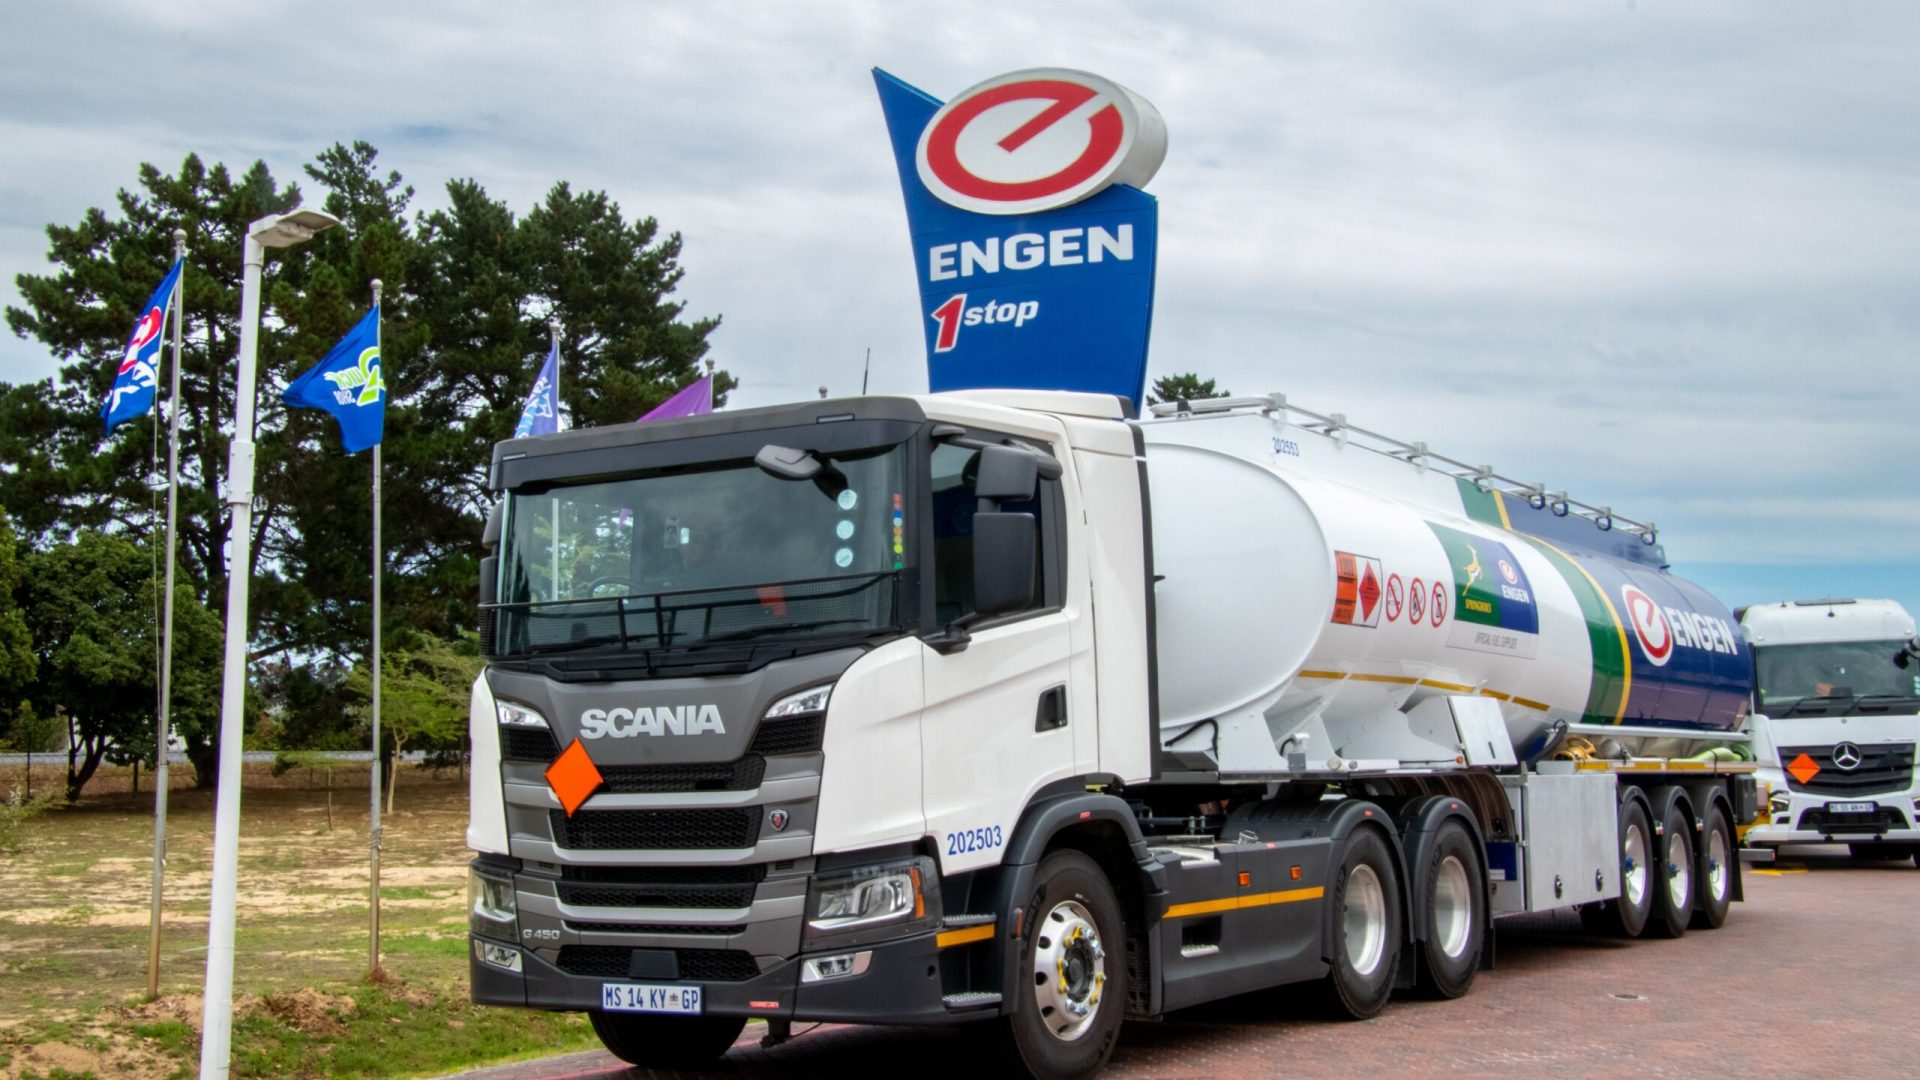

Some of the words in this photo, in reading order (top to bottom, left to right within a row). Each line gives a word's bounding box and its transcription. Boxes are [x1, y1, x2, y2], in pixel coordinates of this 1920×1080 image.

[929, 223, 1134, 282] ENGEN
[963, 299, 1040, 328] stop
[1501, 584, 1530, 604] ENGEN
[1663, 606, 1738, 656] ENGEN
[579, 703, 726, 740] SCANIA
[947, 825, 1003, 856] 202503
[523, 929, 532, 939] G
[534, 929, 560, 940] 450
[605, 986, 622, 1007] MS
[628, 988, 644, 1008] 14
[650, 989, 667, 1009] KY
[682, 989, 699, 1010] GP
